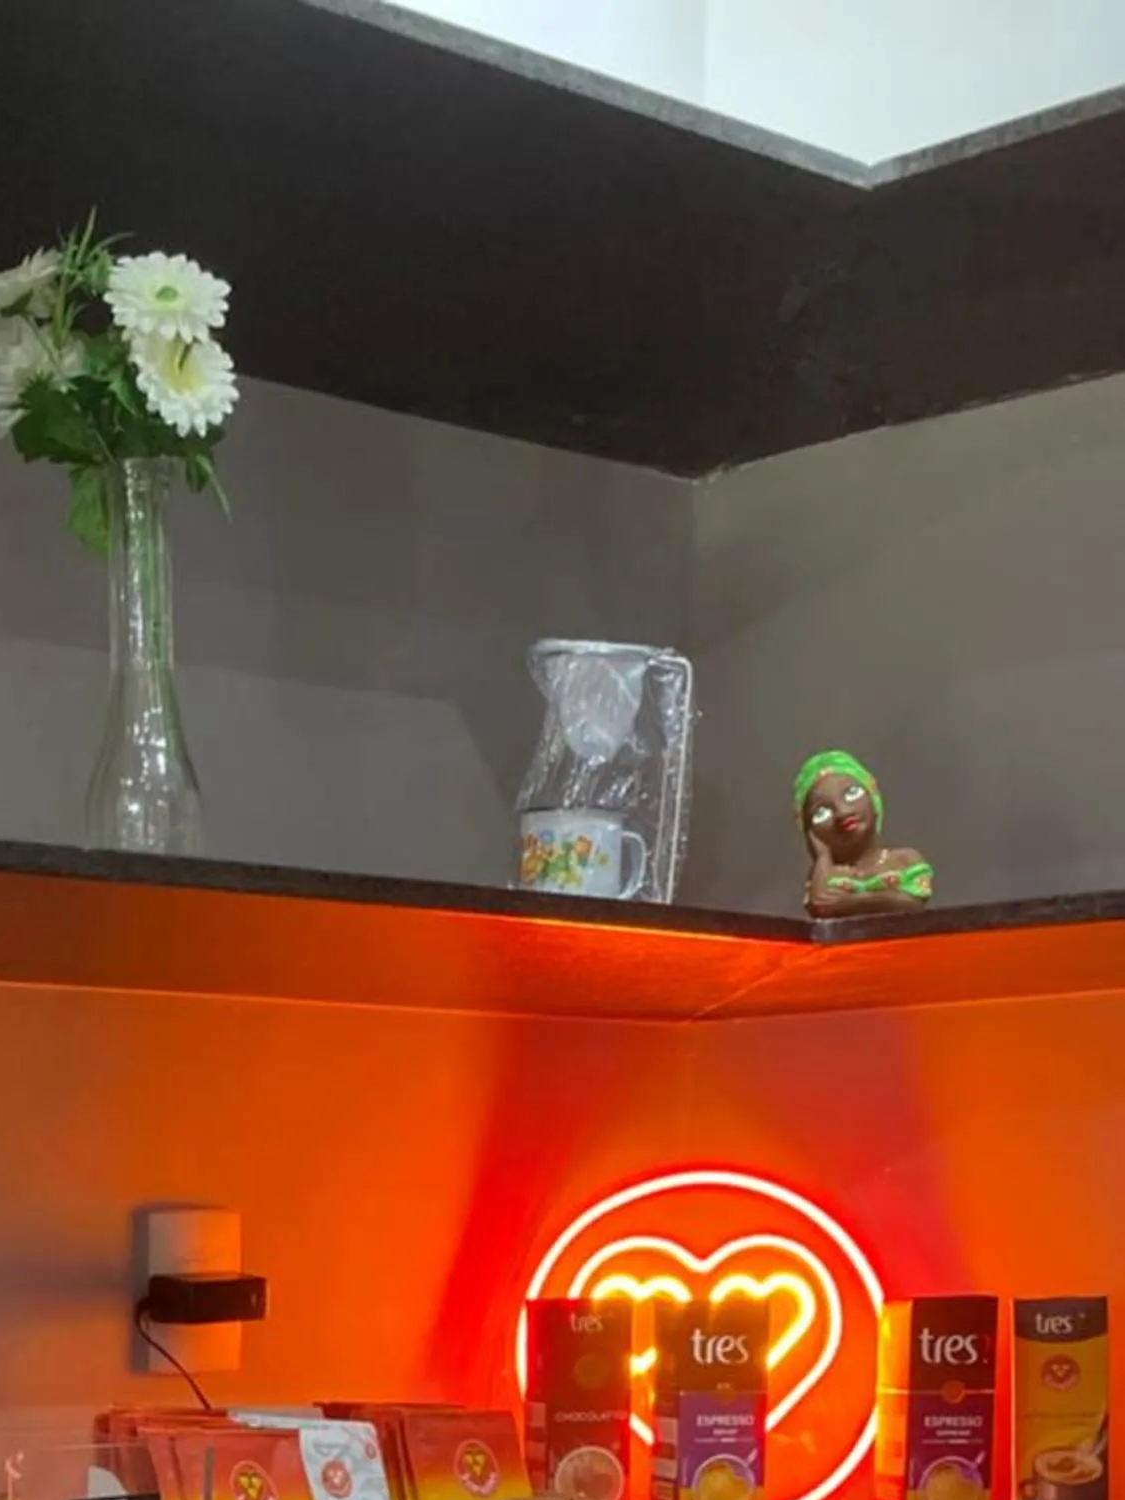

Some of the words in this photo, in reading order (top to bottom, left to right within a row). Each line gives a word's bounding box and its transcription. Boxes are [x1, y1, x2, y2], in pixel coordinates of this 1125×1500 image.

[1035, 1312, 1074, 1334] tres
[690, 1328, 749, 1364] tres
[918, 1327, 978, 1365] tres
